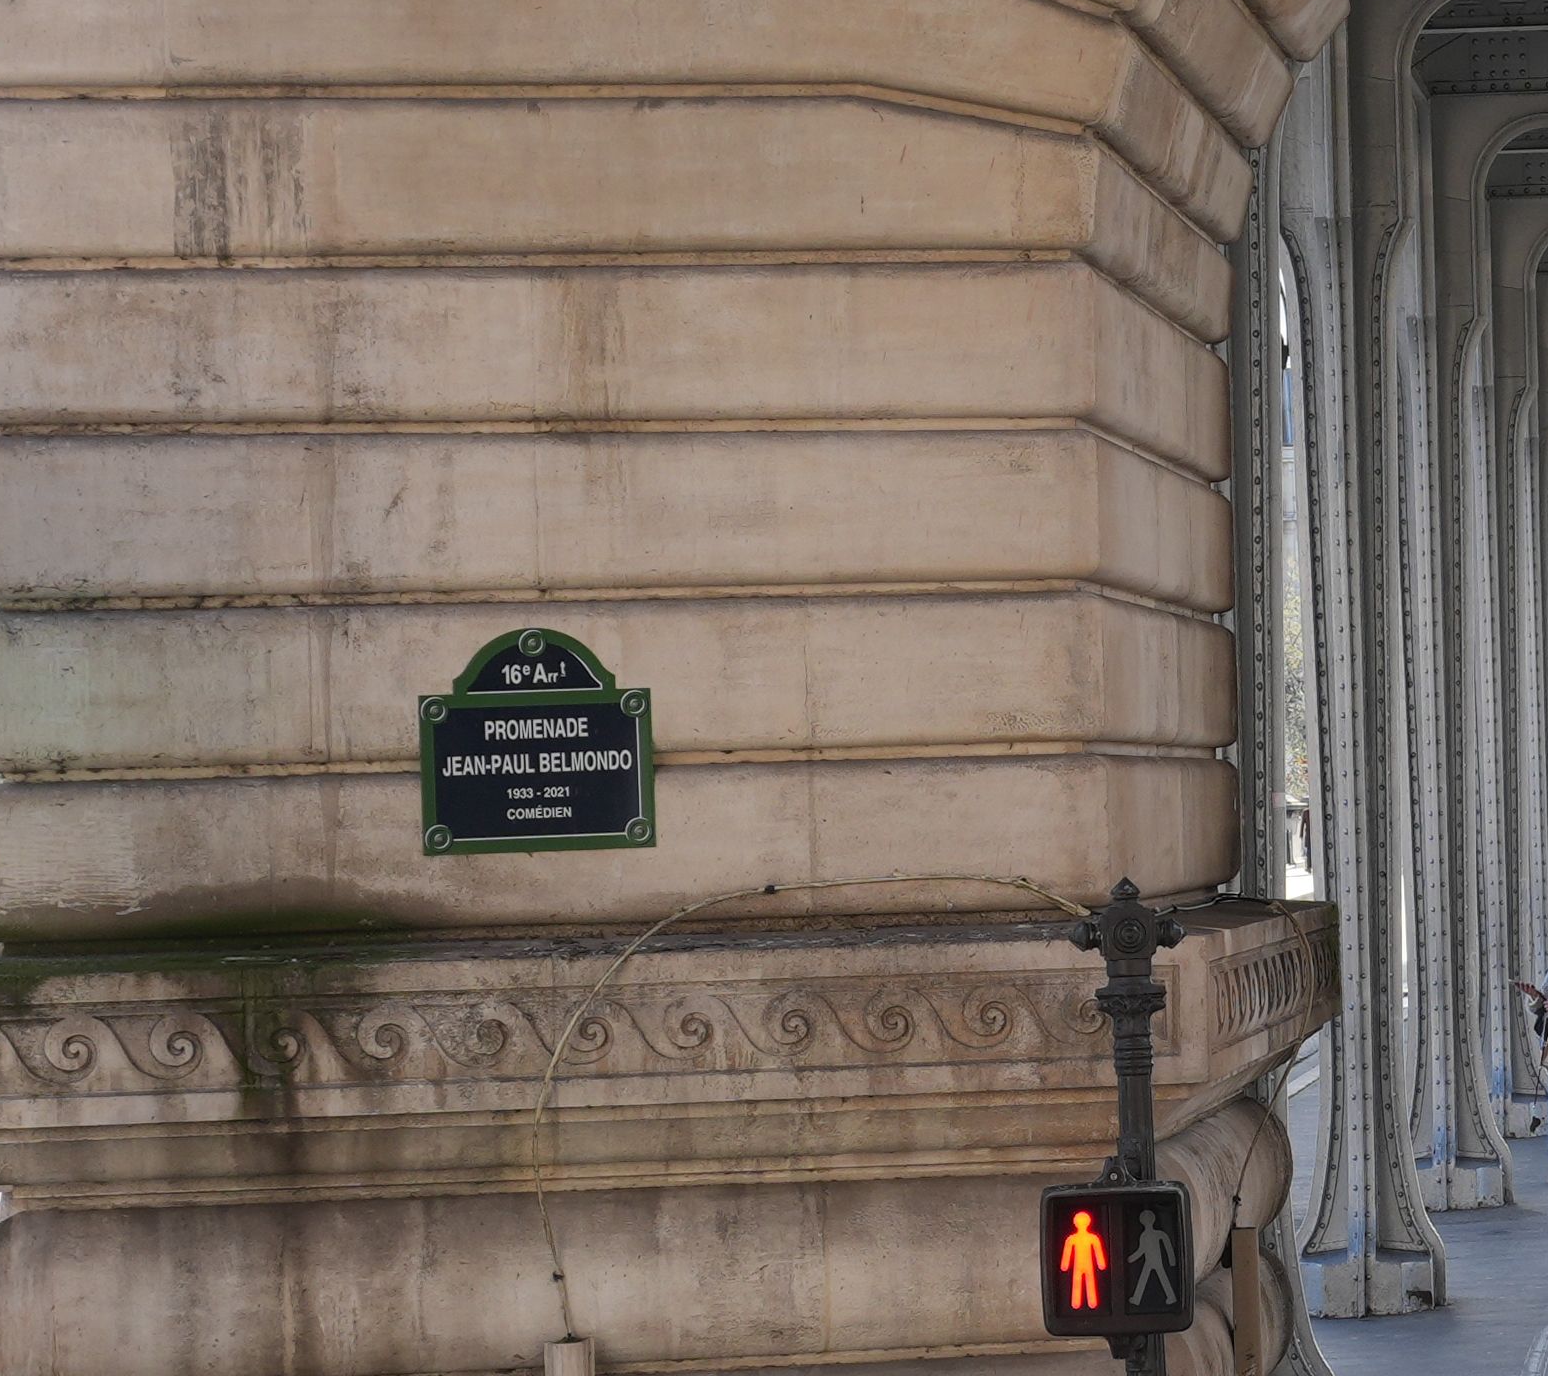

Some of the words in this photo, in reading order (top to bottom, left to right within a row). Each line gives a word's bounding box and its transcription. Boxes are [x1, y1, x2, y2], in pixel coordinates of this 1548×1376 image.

[484, 717, 589, 741] PROMENADE
[442, 753, 535, 777] JEAN-PAUL
[539, 749, 633, 773] BELMONDO
[507, 787, 534, 800] 1933
[543, 786, 570, 798] 2021
[506, 805, 572, 820] COMÉDIEN
